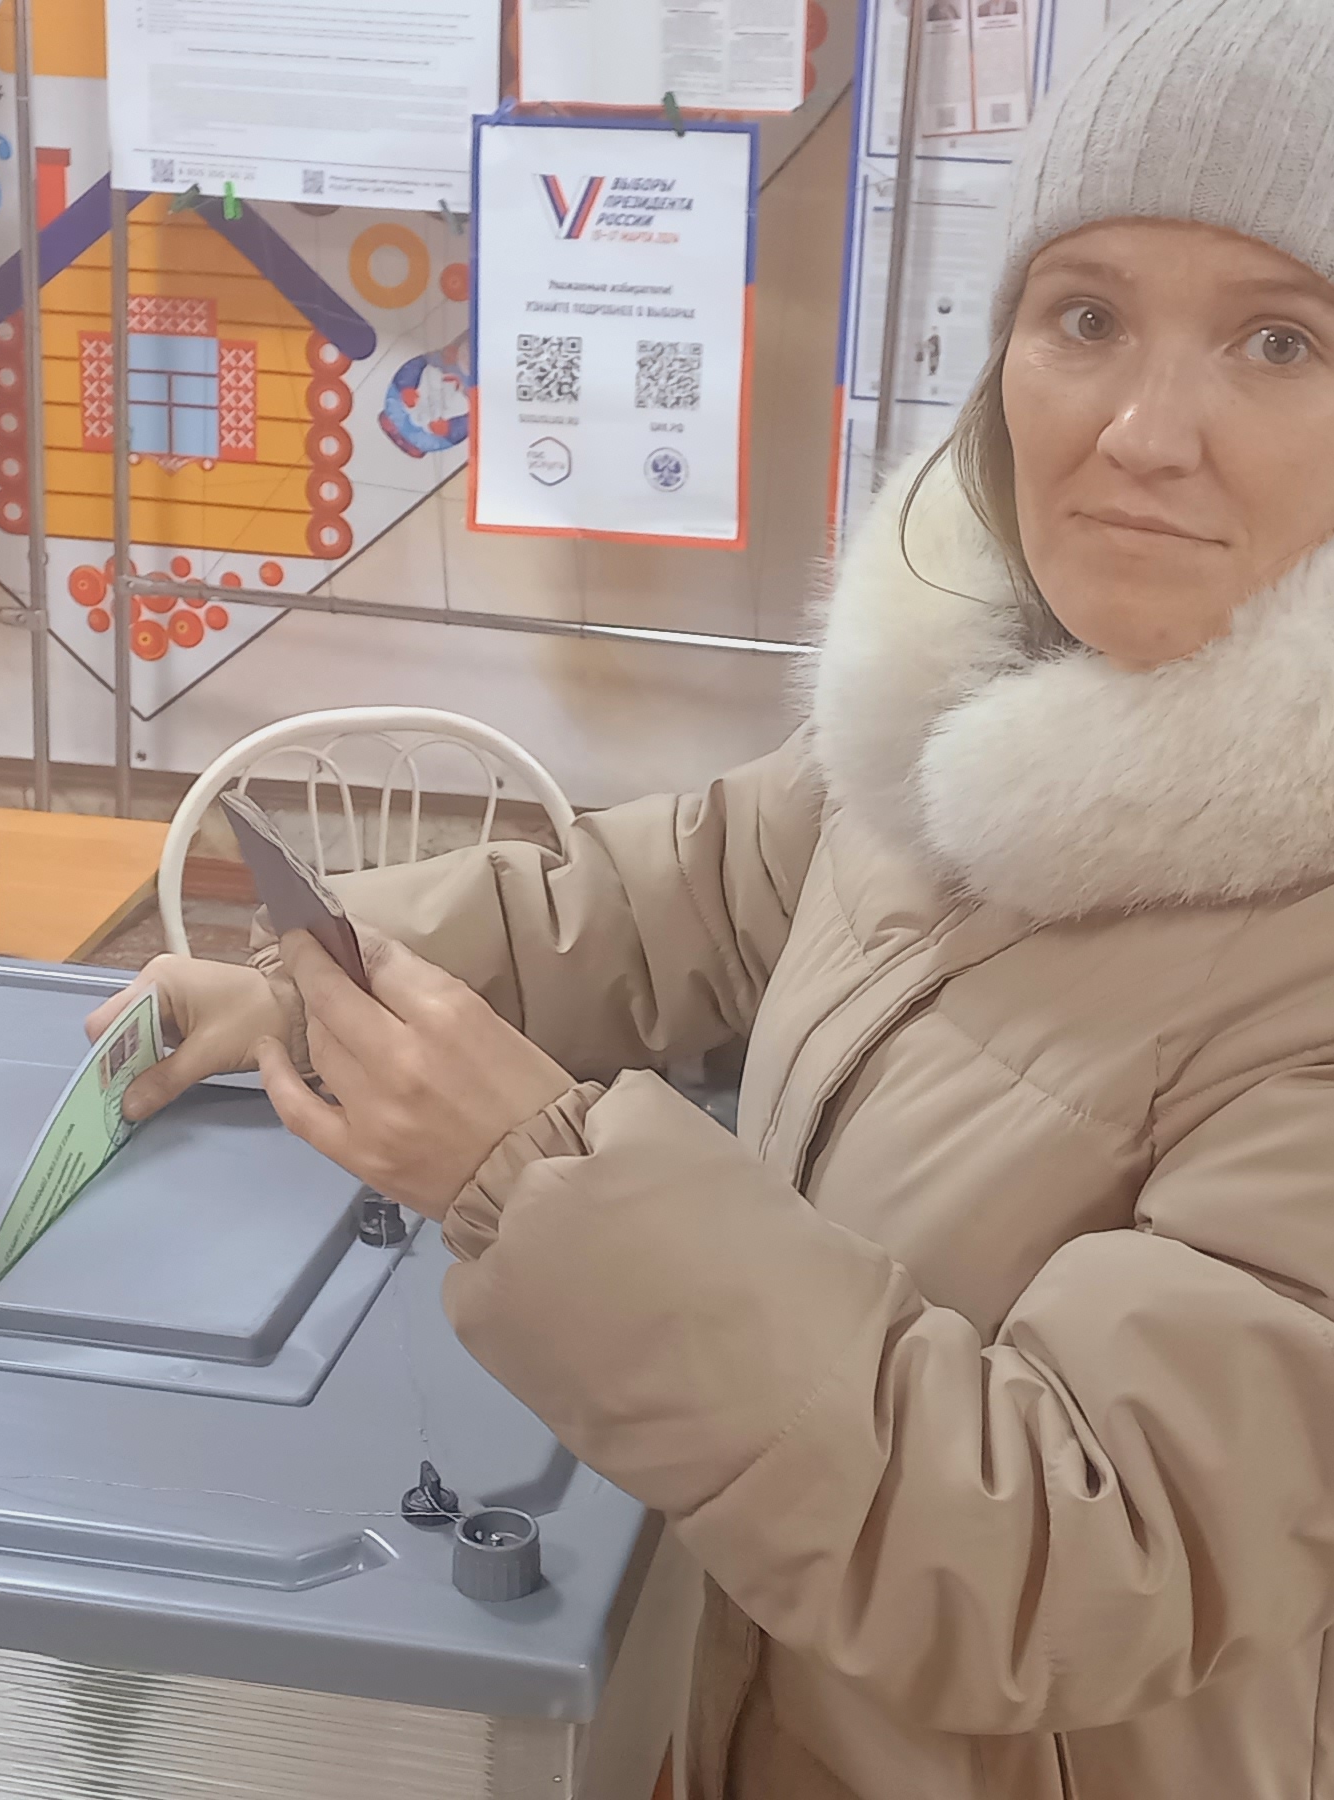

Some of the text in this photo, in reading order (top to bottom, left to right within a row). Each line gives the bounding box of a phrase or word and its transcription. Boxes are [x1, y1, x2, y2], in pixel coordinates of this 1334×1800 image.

[610, 176, 676, 192] ВЫБОРЫ
[603, 194, 695, 211] ПРЕЗИДЕНТА
[595, 212, 655, 227] РОССИИ
[525, 300, 570, 314] УЗНАЙТЕ
[572, 302, 634, 317] ПОДРОБНЕЕ
[646, 305, 696, 319] ВЫБОРАХ
